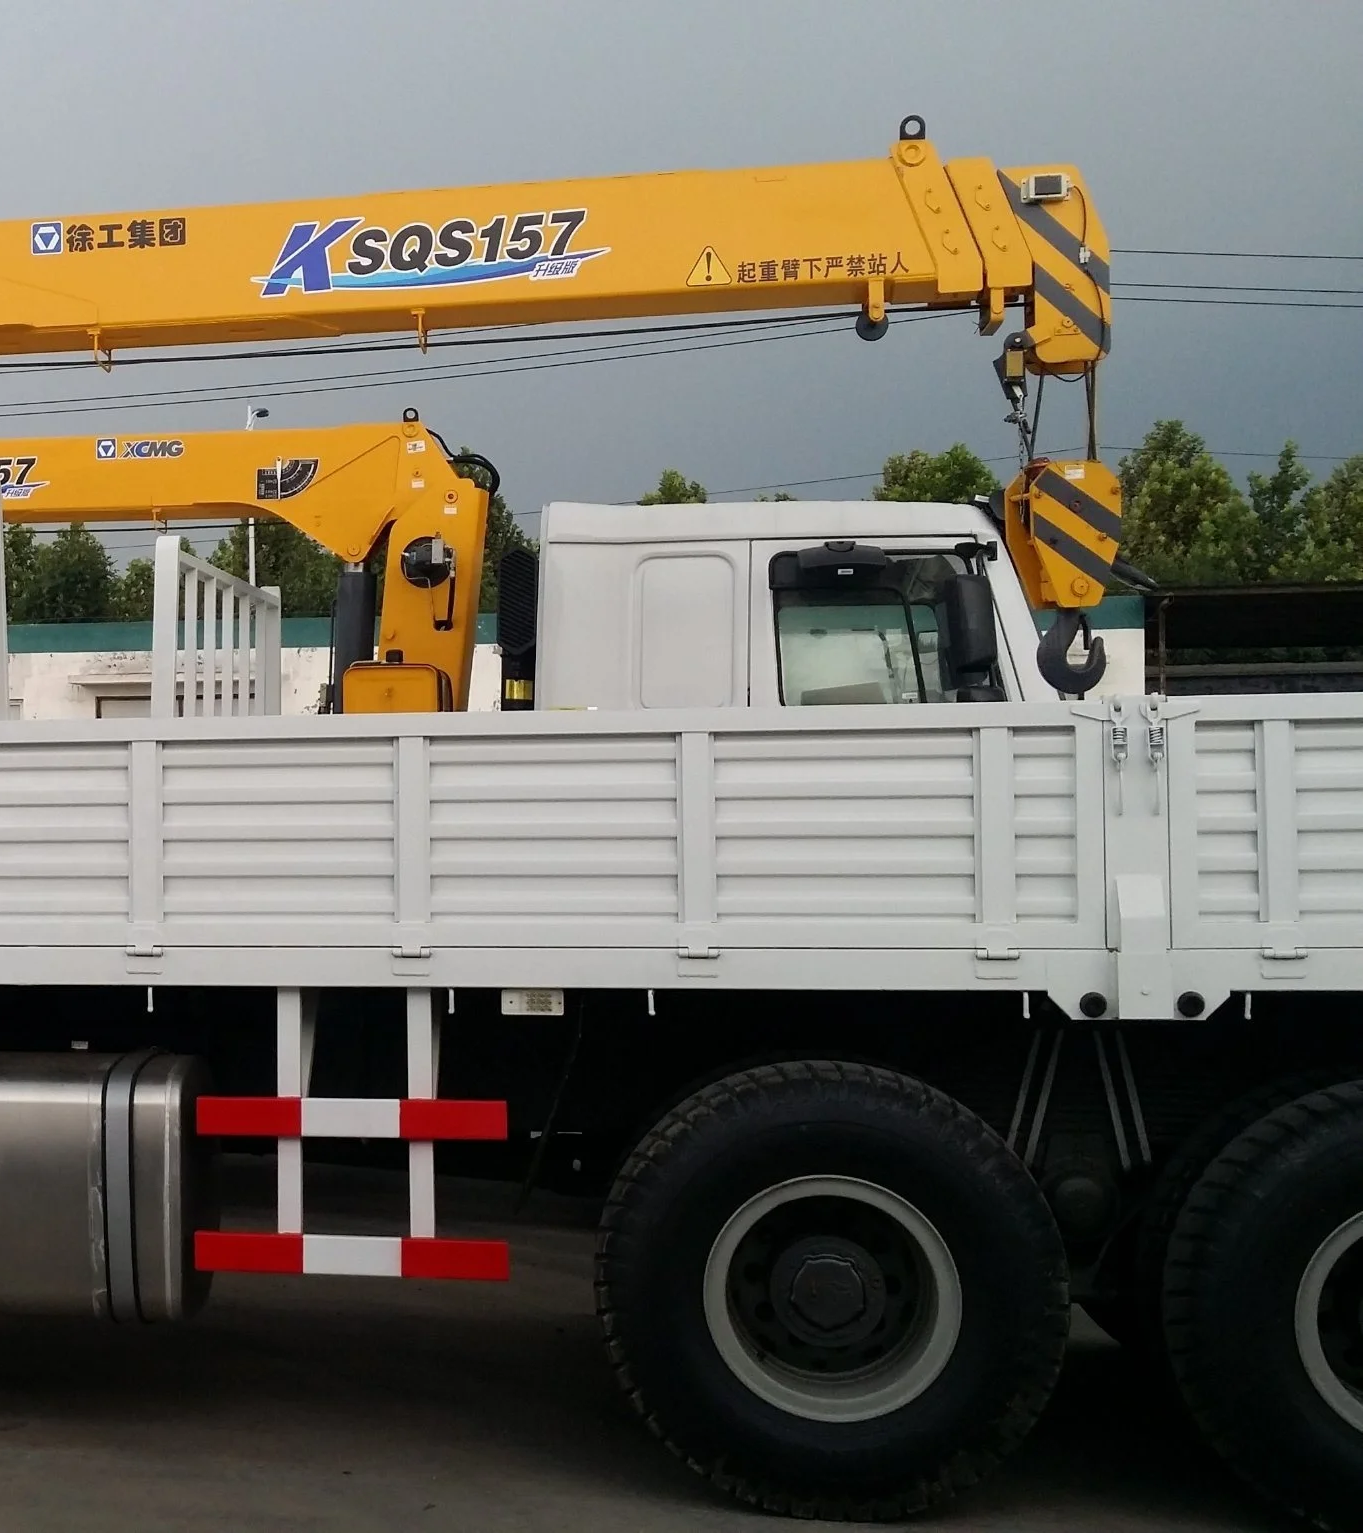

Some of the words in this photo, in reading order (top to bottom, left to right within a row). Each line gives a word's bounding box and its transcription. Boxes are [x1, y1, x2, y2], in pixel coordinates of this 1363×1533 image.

[66, 217, 186, 253] 徐工集团
[347, 209, 587, 276] SQS157
[534, 259, 579, 278] 升级版
[736, 251, 910, 284] 起重臂下严禁站人
[119, 440, 184, 459] XCMG
